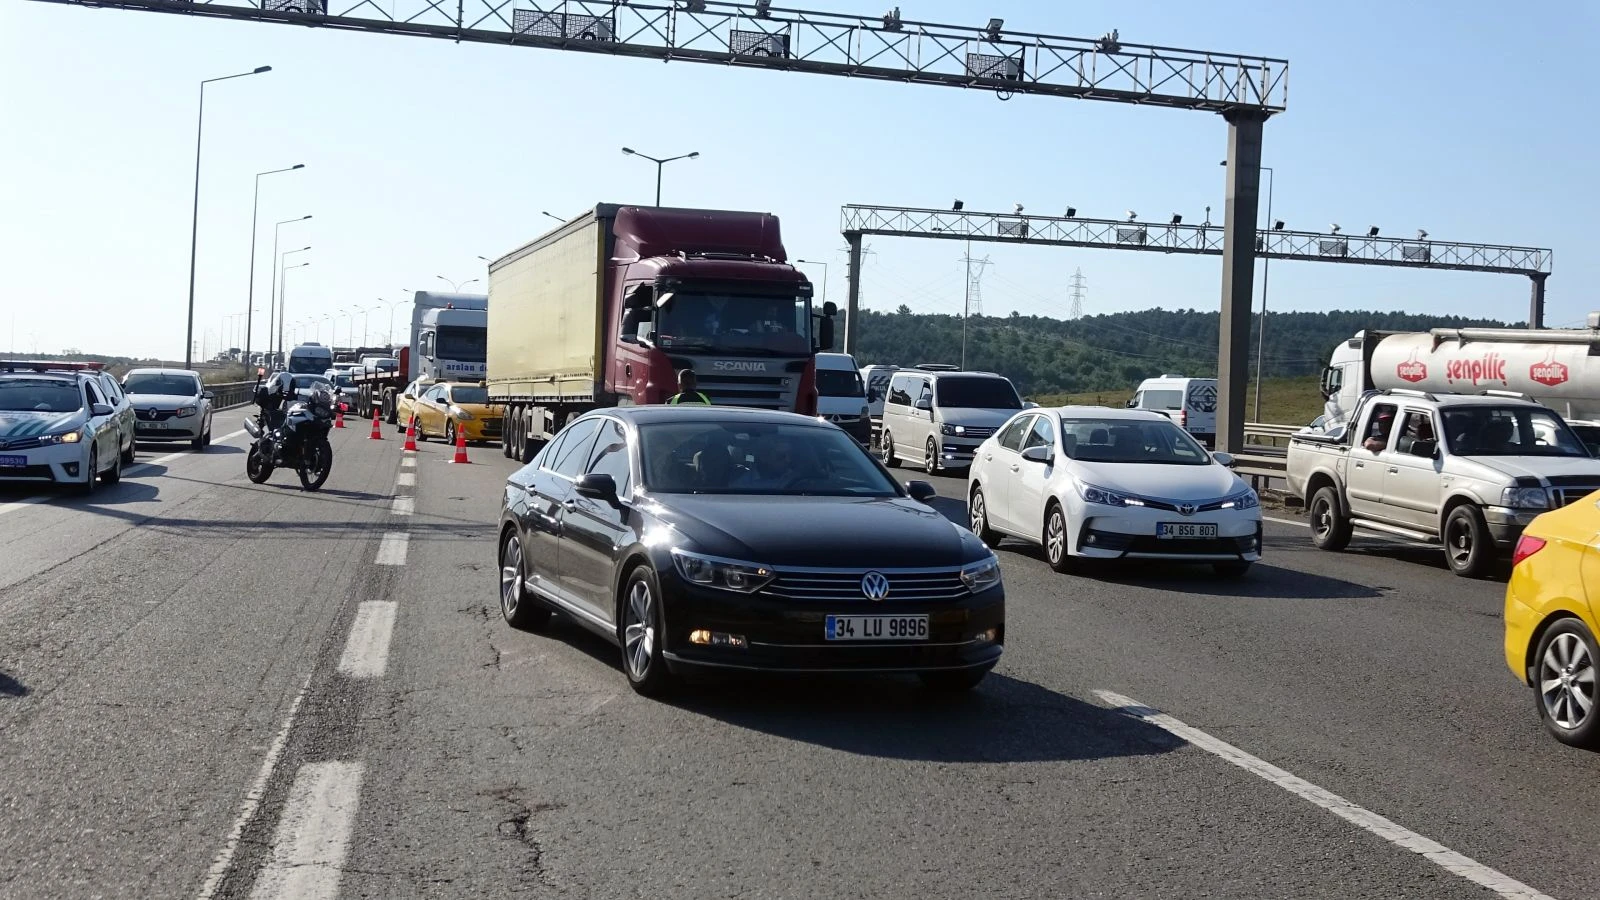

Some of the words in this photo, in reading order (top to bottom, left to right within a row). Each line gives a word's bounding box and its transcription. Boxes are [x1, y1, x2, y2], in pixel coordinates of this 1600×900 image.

[712, 361, 766, 371] SCANIA
[1447, 353, 1507, 386] şenpiliç
[1533, 364, 1564, 381] şenpiliç
[1163, 525, 1174, 535] 34
[1179, 525, 1195, 535] BSG
[1200, 526, 1215, 536] 803
[836, 619, 854, 637] 34
[864, 619, 882, 637] LU
[889, 618, 926, 637] 9896
